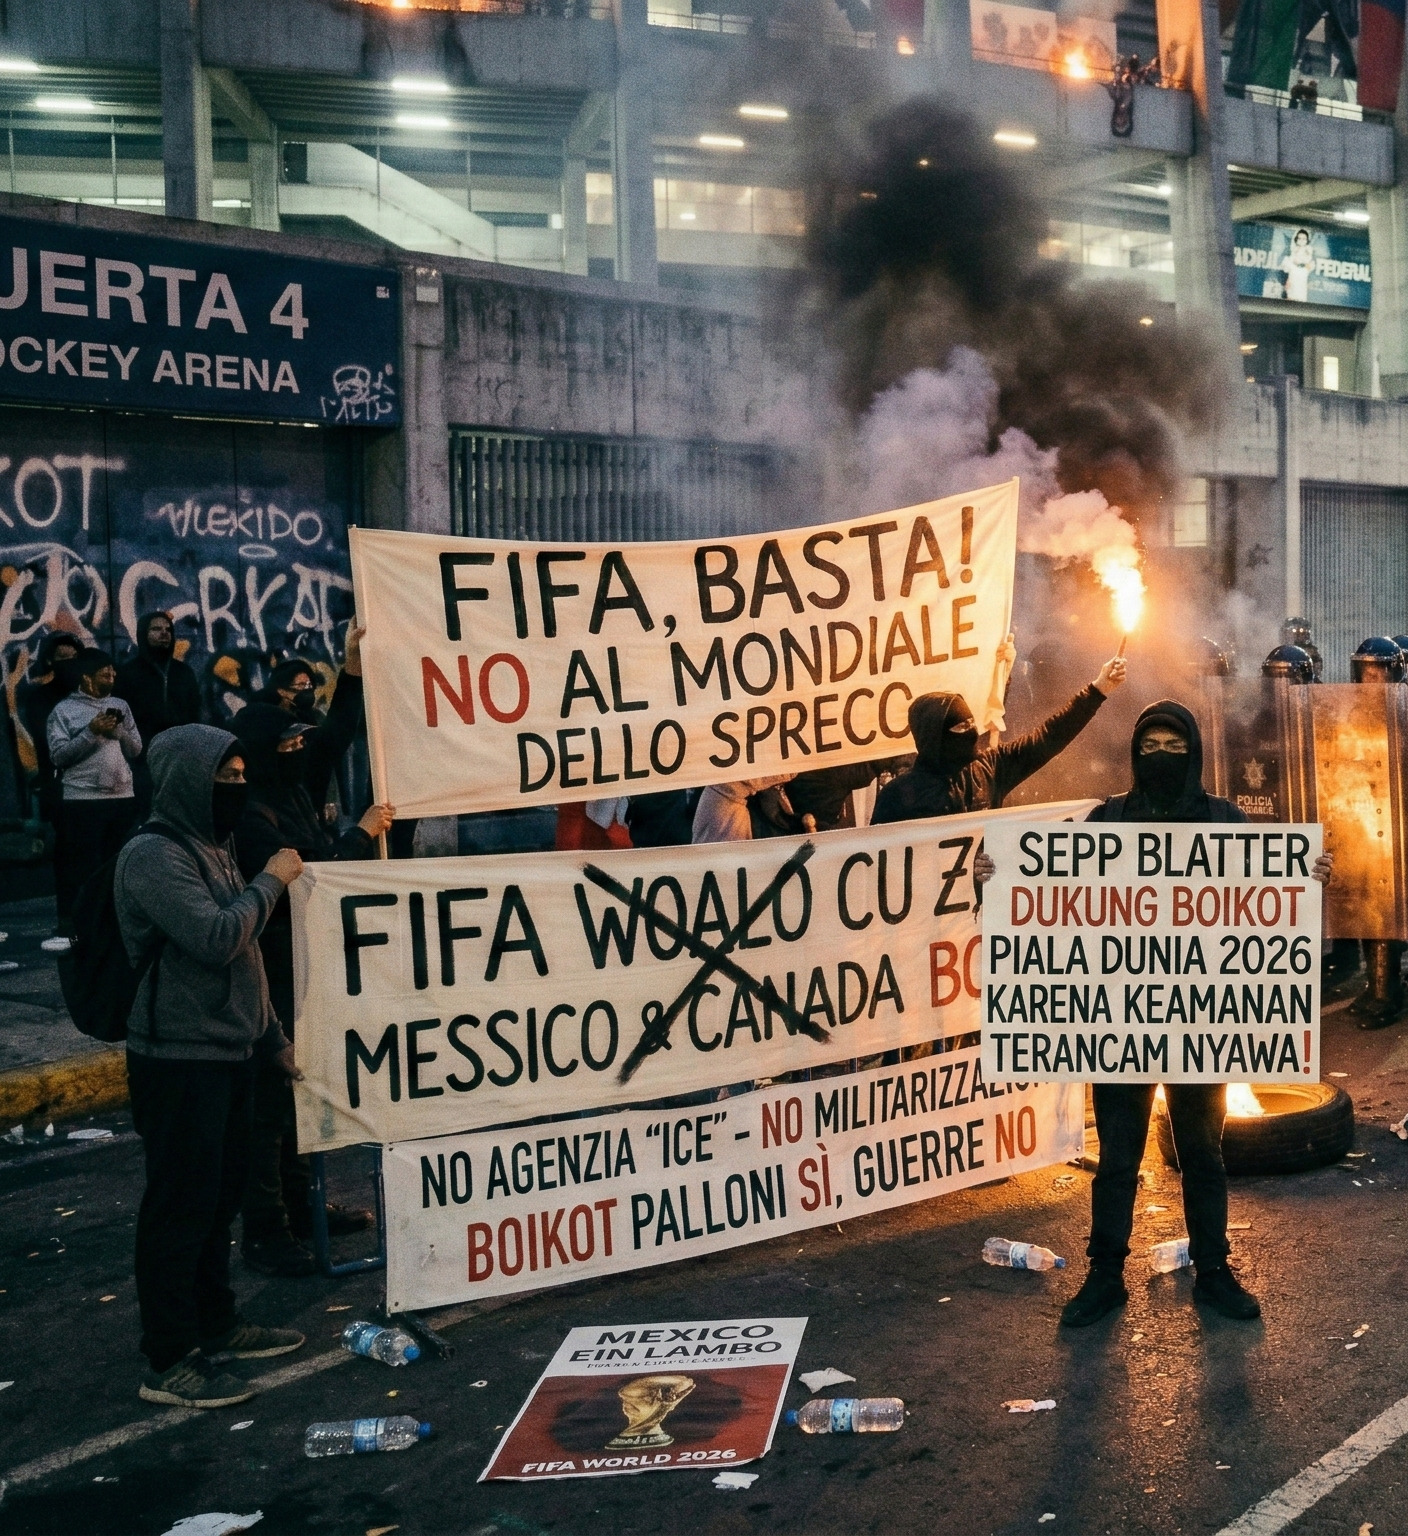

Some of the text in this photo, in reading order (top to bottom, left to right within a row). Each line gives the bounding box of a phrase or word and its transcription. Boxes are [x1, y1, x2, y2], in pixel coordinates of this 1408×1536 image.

[269, 282, 310, 340] 4
[152, 350, 301, 394] ARENA
[438, 506, 975, 642] FIFA, BASTA!
[421, 595, 979, 728] NO AL MONDIALE
[519, 719, 687, 794] DELLO
[1236, 795, 1274, 806] POLICIA
[1019, 831, 1310, 877] SEPP BLATTER
[340, 883, 549, 996] FIFA
[837, 843, 914, 931] CU
[1011, 885, 1306, 927] DUKUNG BOIKOT
[990, 935, 1313, 975] PIALA DUNIA 2026
[987, 984, 1312, 1024] KARENA KEAMANAN
[345, 1000, 619, 1109] MESSICO
[688, 953, 905, 1053] CANADA
[990, 1030, 1312, 1075] TERANCAM NYAWA!
[421, 1151, 473, 1208] NO
[487, 1128, 637, 1201] AGENZIA
[761, 1096, 804, 1150] NO
[815, 1058, 1049, 1143] MILITARIZZA
[467, 1198, 619, 1283] BOIKOT
[632, 1163, 789, 1250] PALLONI
[854, 1118, 985, 1198] GUERRE
[995, 1106, 1037, 1163] NO
[569, 1348, 635, 1362] EIN
[644, 1341, 782, 1359] LAMBO
[596, 1325, 774, 1345] MEXICO
[521, 1448, 737, 1473] FIFA WORLD 2026
